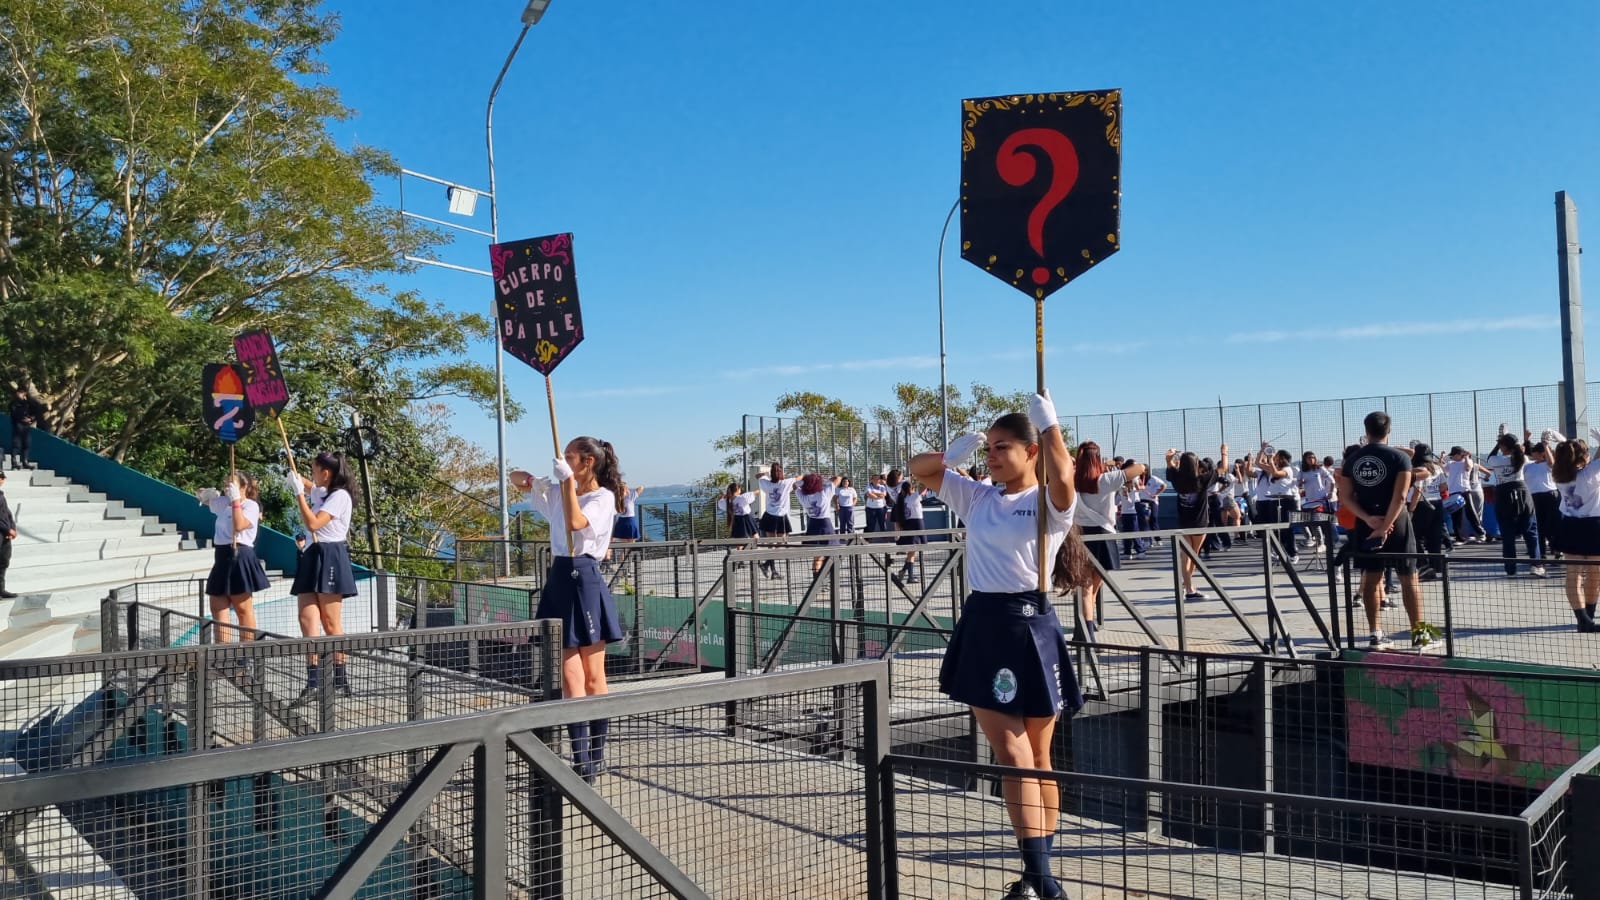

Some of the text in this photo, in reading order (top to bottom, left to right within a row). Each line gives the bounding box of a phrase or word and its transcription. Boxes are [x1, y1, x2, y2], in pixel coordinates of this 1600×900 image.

[499, 263, 562, 295] CUERPO
[526, 289, 545, 308] DE
[504, 313, 575, 339] BAILE
